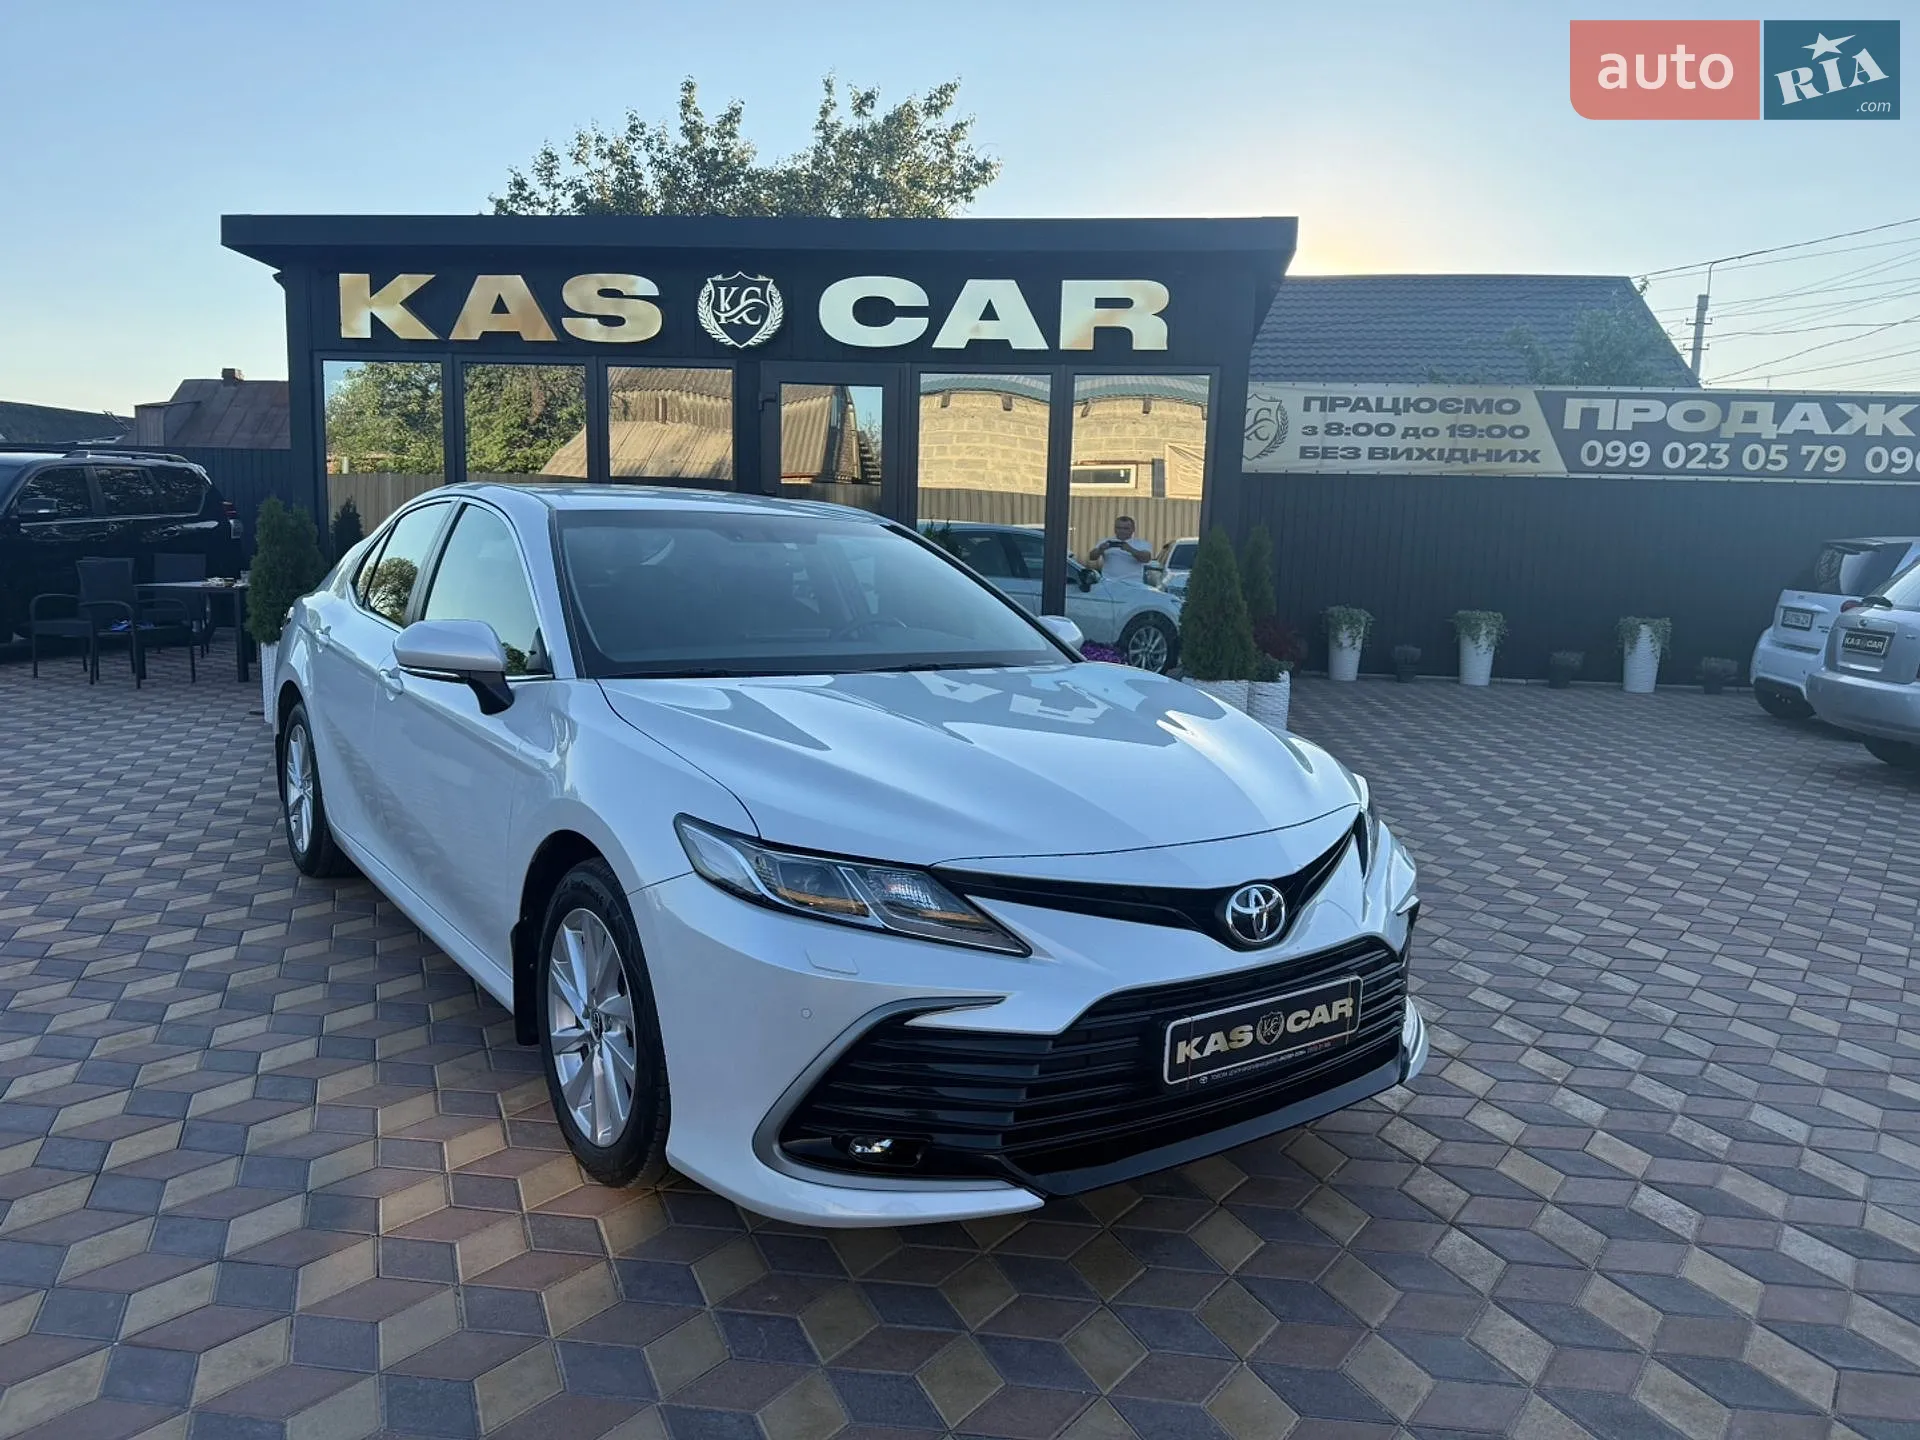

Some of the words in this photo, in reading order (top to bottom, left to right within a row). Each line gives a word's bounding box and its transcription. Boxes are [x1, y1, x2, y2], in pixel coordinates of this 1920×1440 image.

[338, 272, 663, 343] KAS
[818, 275, 1170, 352] CAR
[1302, 396, 1521, 416] ПРАЦЮЄМО
[1562, 397, 1920, 440] ПРОДАЖ
[1323, 422, 1396, 437] 8:00
[1401, 426, 1440, 440] до
[1445, 423, 1531, 440] 19:00
[1298, 445, 1362, 460] БЕЗ
[1367, 446, 1542, 464] ВИХІДНИХ
[1580, 439, 1651, 468] 099
[1661, 441, 1730, 470] 023
[1741, 443, 1789, 472] 05
[1800, 445, 1847, 473] 79
[1175, 1024, 1254, 1065] KAS
[1285, 997, 1355, 1034] CAR
